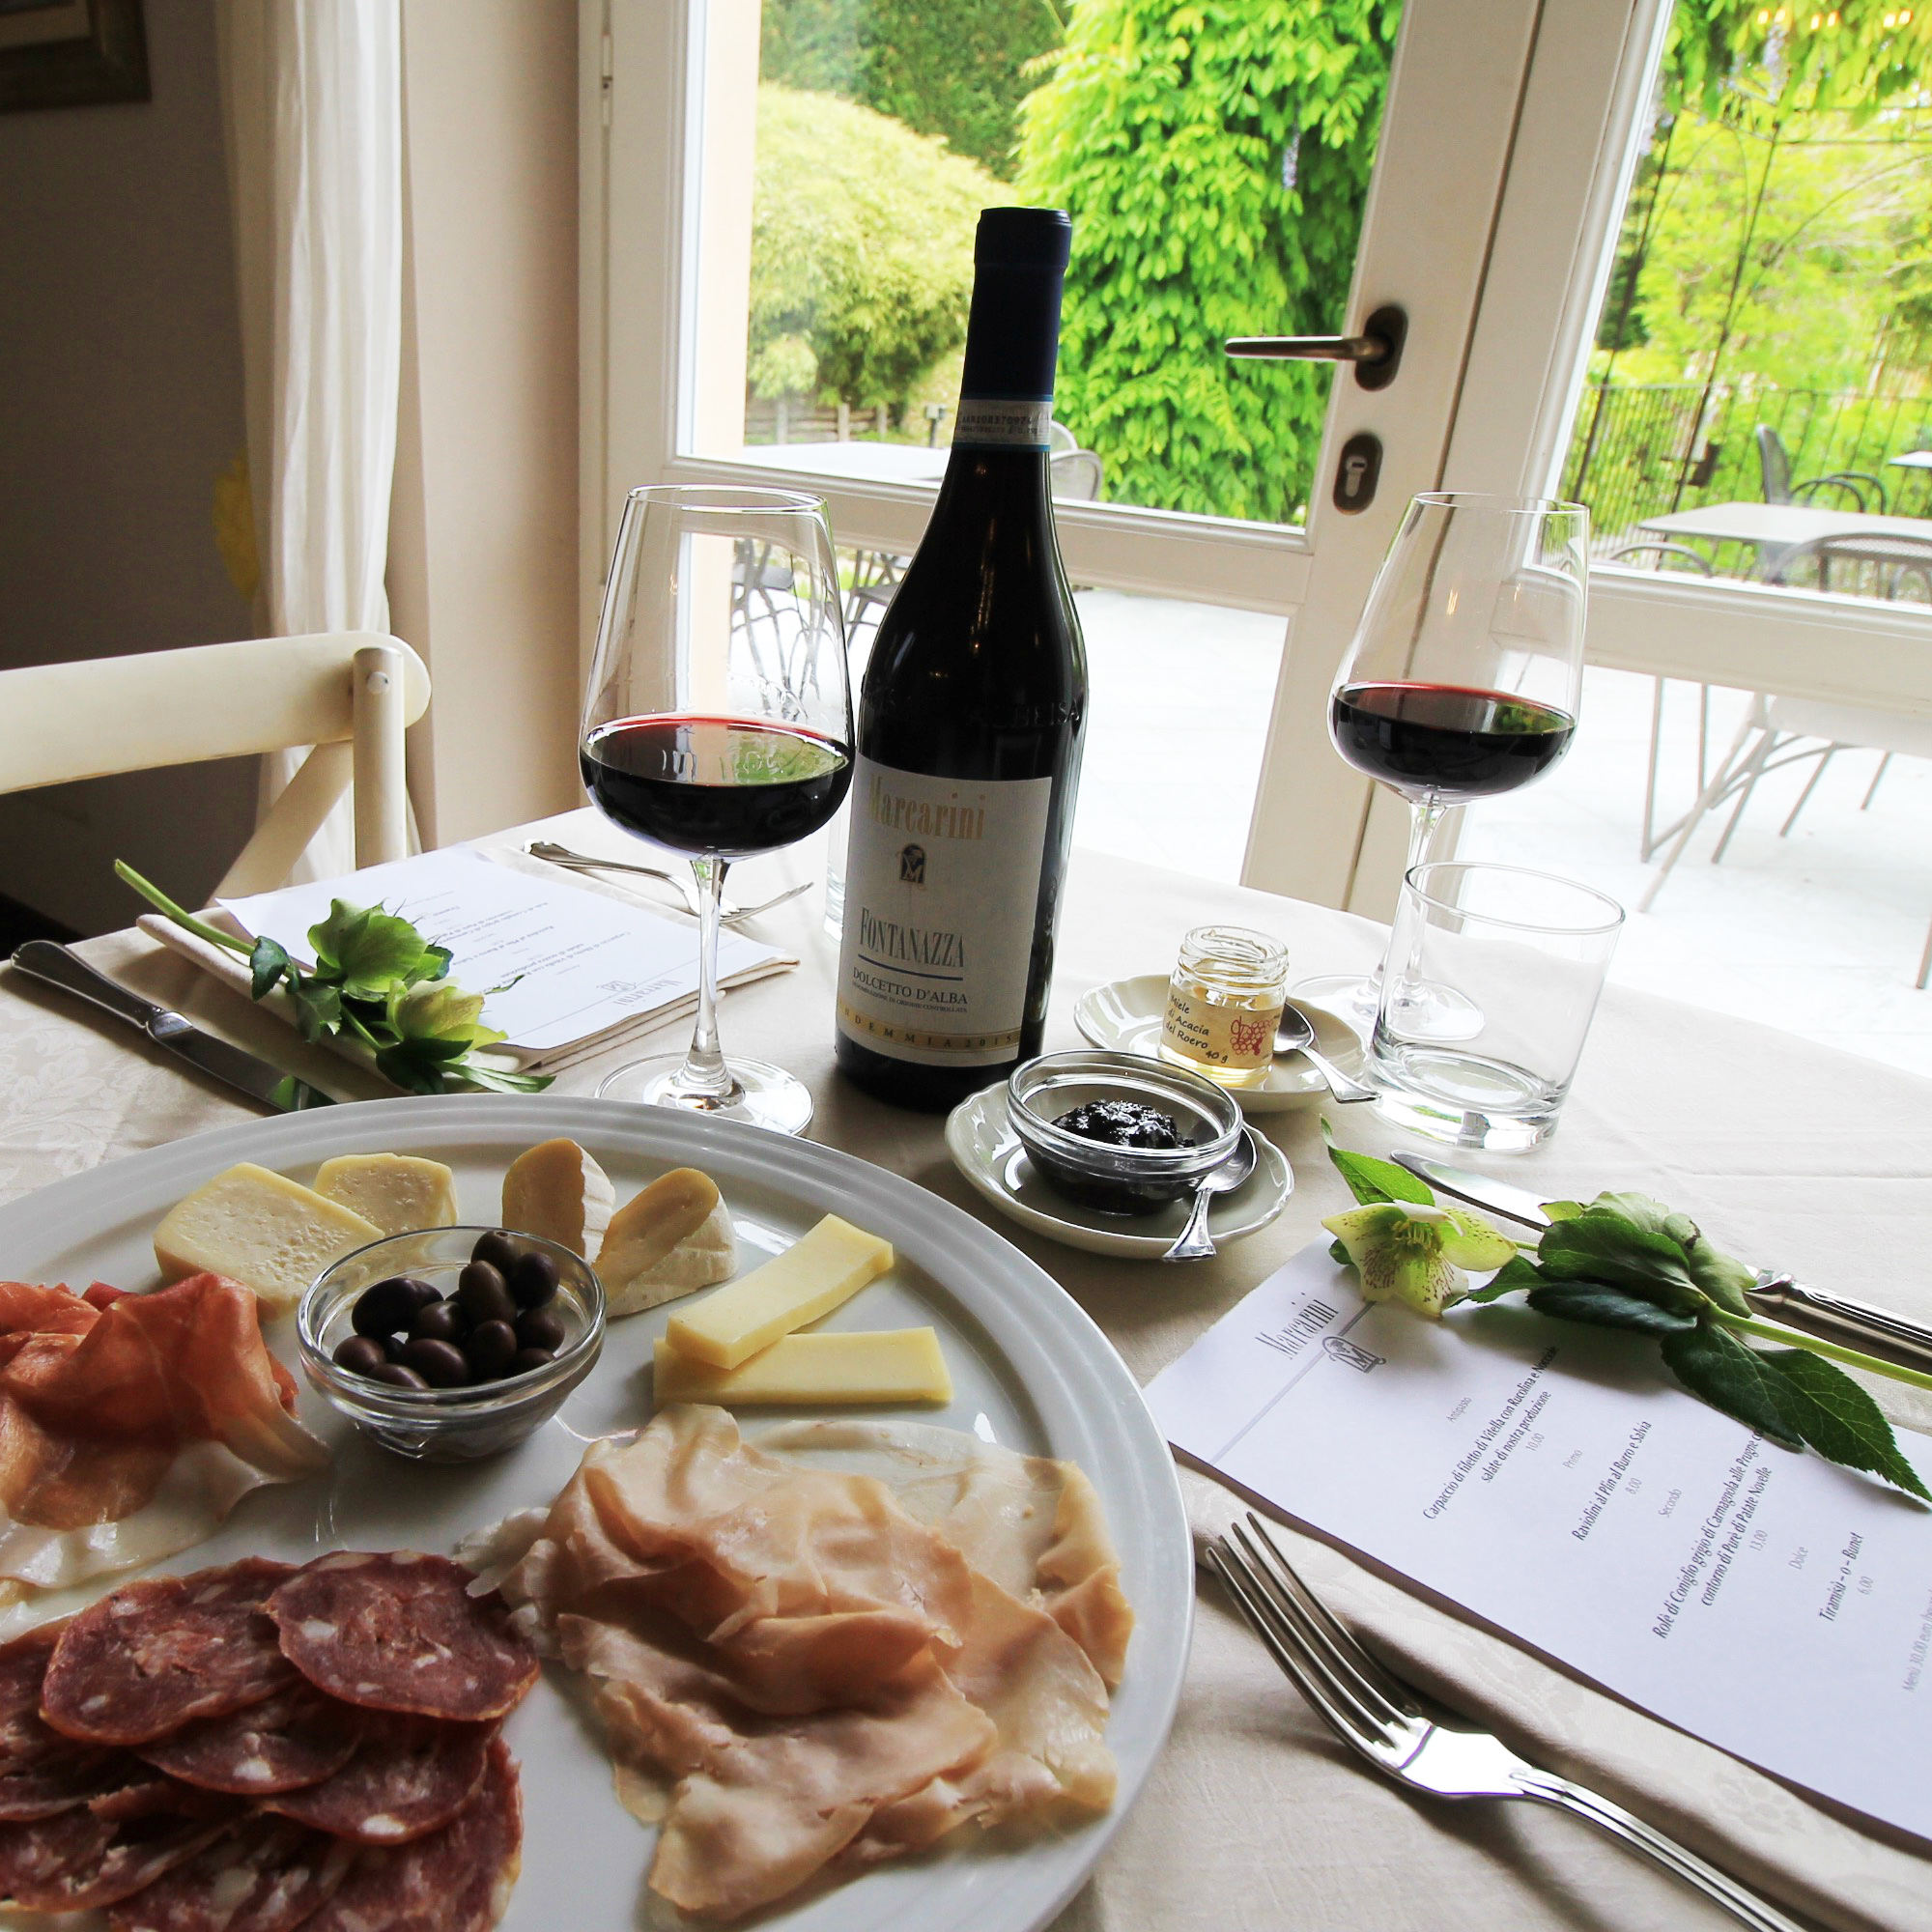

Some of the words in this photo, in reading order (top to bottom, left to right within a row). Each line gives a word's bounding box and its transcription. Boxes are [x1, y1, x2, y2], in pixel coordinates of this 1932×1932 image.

[859, 906, 965, 967] FONTANAZZA
[852, 967, 912, 998] DOLCETTO
[916, 988, 968, 1005] D'ALBA
[1170, 994, 1190, 1013] Miele
[1165, 1021, 1177, 1035] del
[1177, 1029, 1208, 1049] Roero
[1168, 1008, 1176, 1018] di
[1176, 1015, 1209, 1036] Acacia
[1205, 1050, 1220, 1060] 40
[1506, 1378, 1537, 1407] Rucolina
[1445, 1397, 1472, 1424] Antipasto
[1500, 1405, 1516, 1420] con
[1479, 1418, 1506, 1442] Vitella
[1481, 1459, 1503, 1484] salate
[1502, 1428, 1525, 1453] nostra
[1519, 1391, 1552, 1433] produzione
[1524, 1433, 1546, 1452] 10,00
[1456, 1450, 1483, 1474] filetto
[1561, 1449, 1583, 1469] Primo
[1735, 1439, 1759, 1468] Prugne
[1571, 1500, 1604, 1542] Raviolini
[1598, 1478, 1618, 1496] Plin
[1612, 1448, 1635, 1471] Burro
[1629, 1421, 1652, 1444] Salvia
[1624, 1477, 1642, 1495] 8,00
[1728, 1465, 1747, 1483] alle
[1422, 1481, 1460, 1520] Carpaccio
[1657, 1488, 1683, 1519] Secondo
[1705, 1480, 1740, 1528] Carmagnola
[1700, 1563, 1728, 1606] contorno
[1720, 1531, 1743, 1554] Purè
[1735, 1496, 1759, 1523] Patate
[1747, 1466, 1773, 1498] Novelle
[1748, 1529, 1769, 1551] 13,00
[1690, 1538, 1713, 1568] grigio
[1787, 1546, 1809, 1571] Dolce
[1669, 1564, 1699, 1604] Coniglio
[1818, 1580, 1847, 1622] Tiramisù
[1841, 1531, 1864, 1560] Bunet
[1856, 1576, 1874, 1596] 6,00
[1652, 1614, 1675, 1639] Rolè
